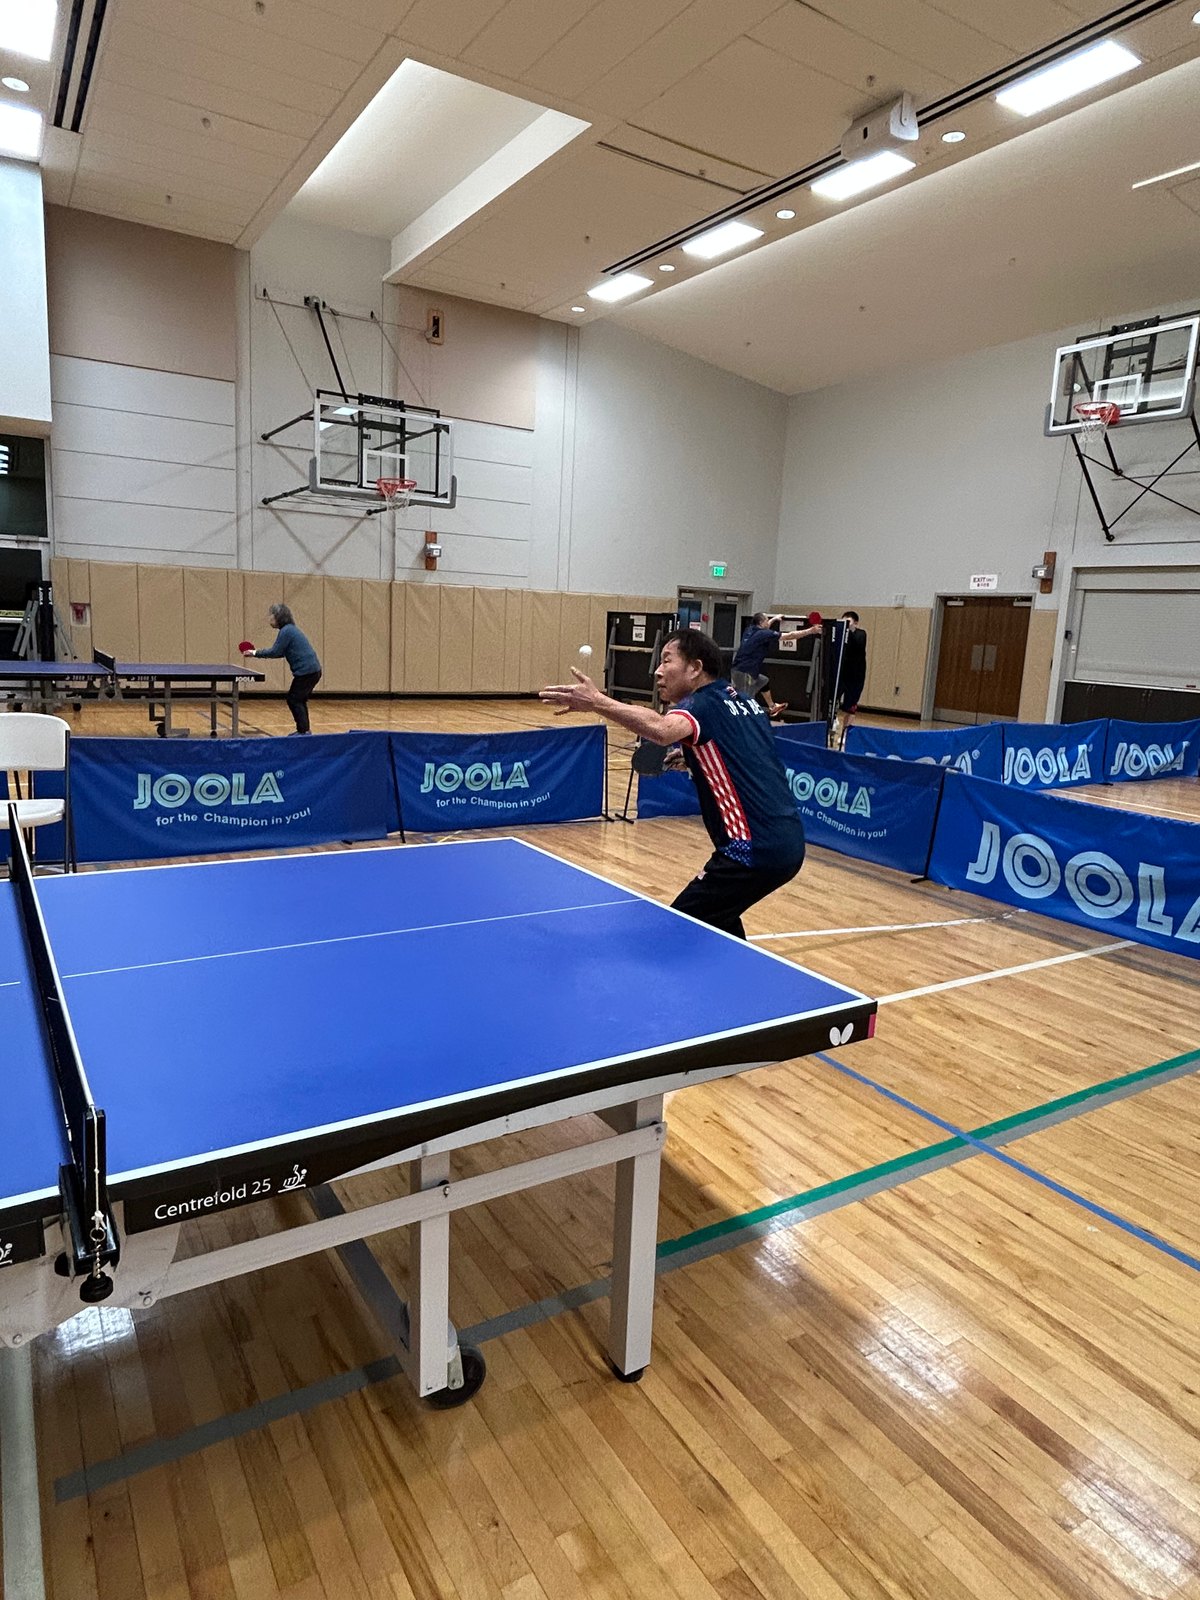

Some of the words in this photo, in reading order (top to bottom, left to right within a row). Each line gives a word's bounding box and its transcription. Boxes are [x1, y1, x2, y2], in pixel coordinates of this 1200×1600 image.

[782, 640, 794, 648] MD
[436, 799, 450, 808] for
[452, 796, 467, 805] the
[470, 796, 519, 810] Champion
[520, 799, 529, 807] in
[530, 792, 551, 807] you!
[156, 813, 175, 826] for
[178, 812, 198, 822] the
[203, 812, 268, 828] Champion
[271, 816, 283, 825] in
[285, 807, 312, 824] you!
[801, 806, 814, 816] the
[816, 811, 856, 836] Champion
[857, 829, 866, 837] in
[867, 829, 887, 839] you!
[154, 1183, 247, 1220] Centrefold
[251, 1178, 272, 1195] 25
